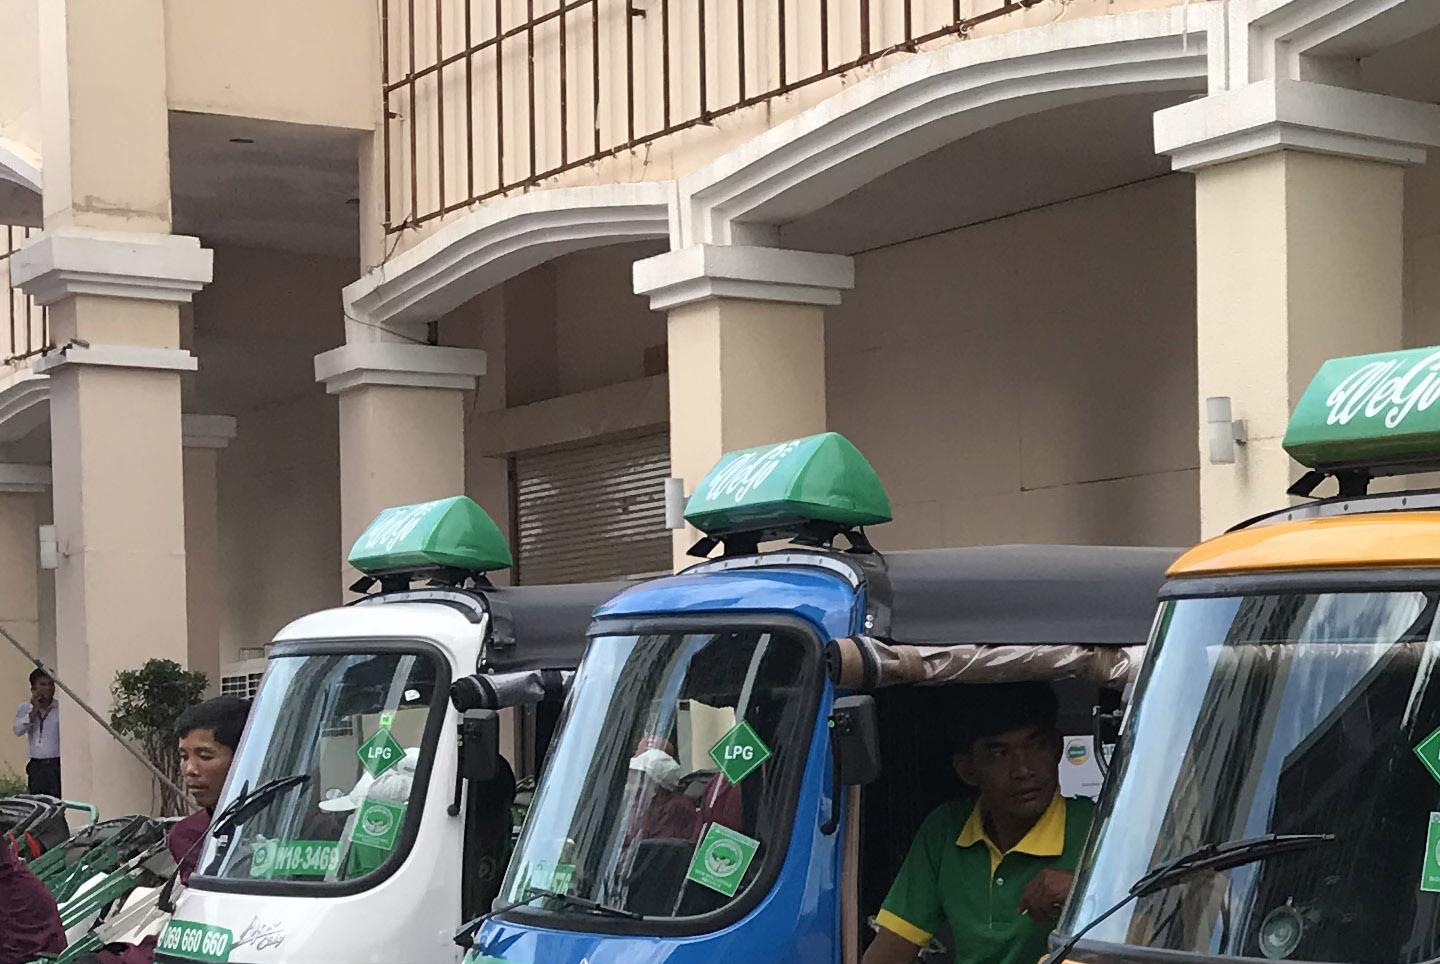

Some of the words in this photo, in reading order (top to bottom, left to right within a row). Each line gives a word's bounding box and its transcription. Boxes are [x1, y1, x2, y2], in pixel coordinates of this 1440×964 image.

[706, 442, 792, 502] WeGo
[367, 746, 392, 760] LPG
[724, 745, 754, 760] LPG
[163, 926, 181, 949] 069
[182, 928, 202, 952] 660
[202, 931, 229, 956] 660
